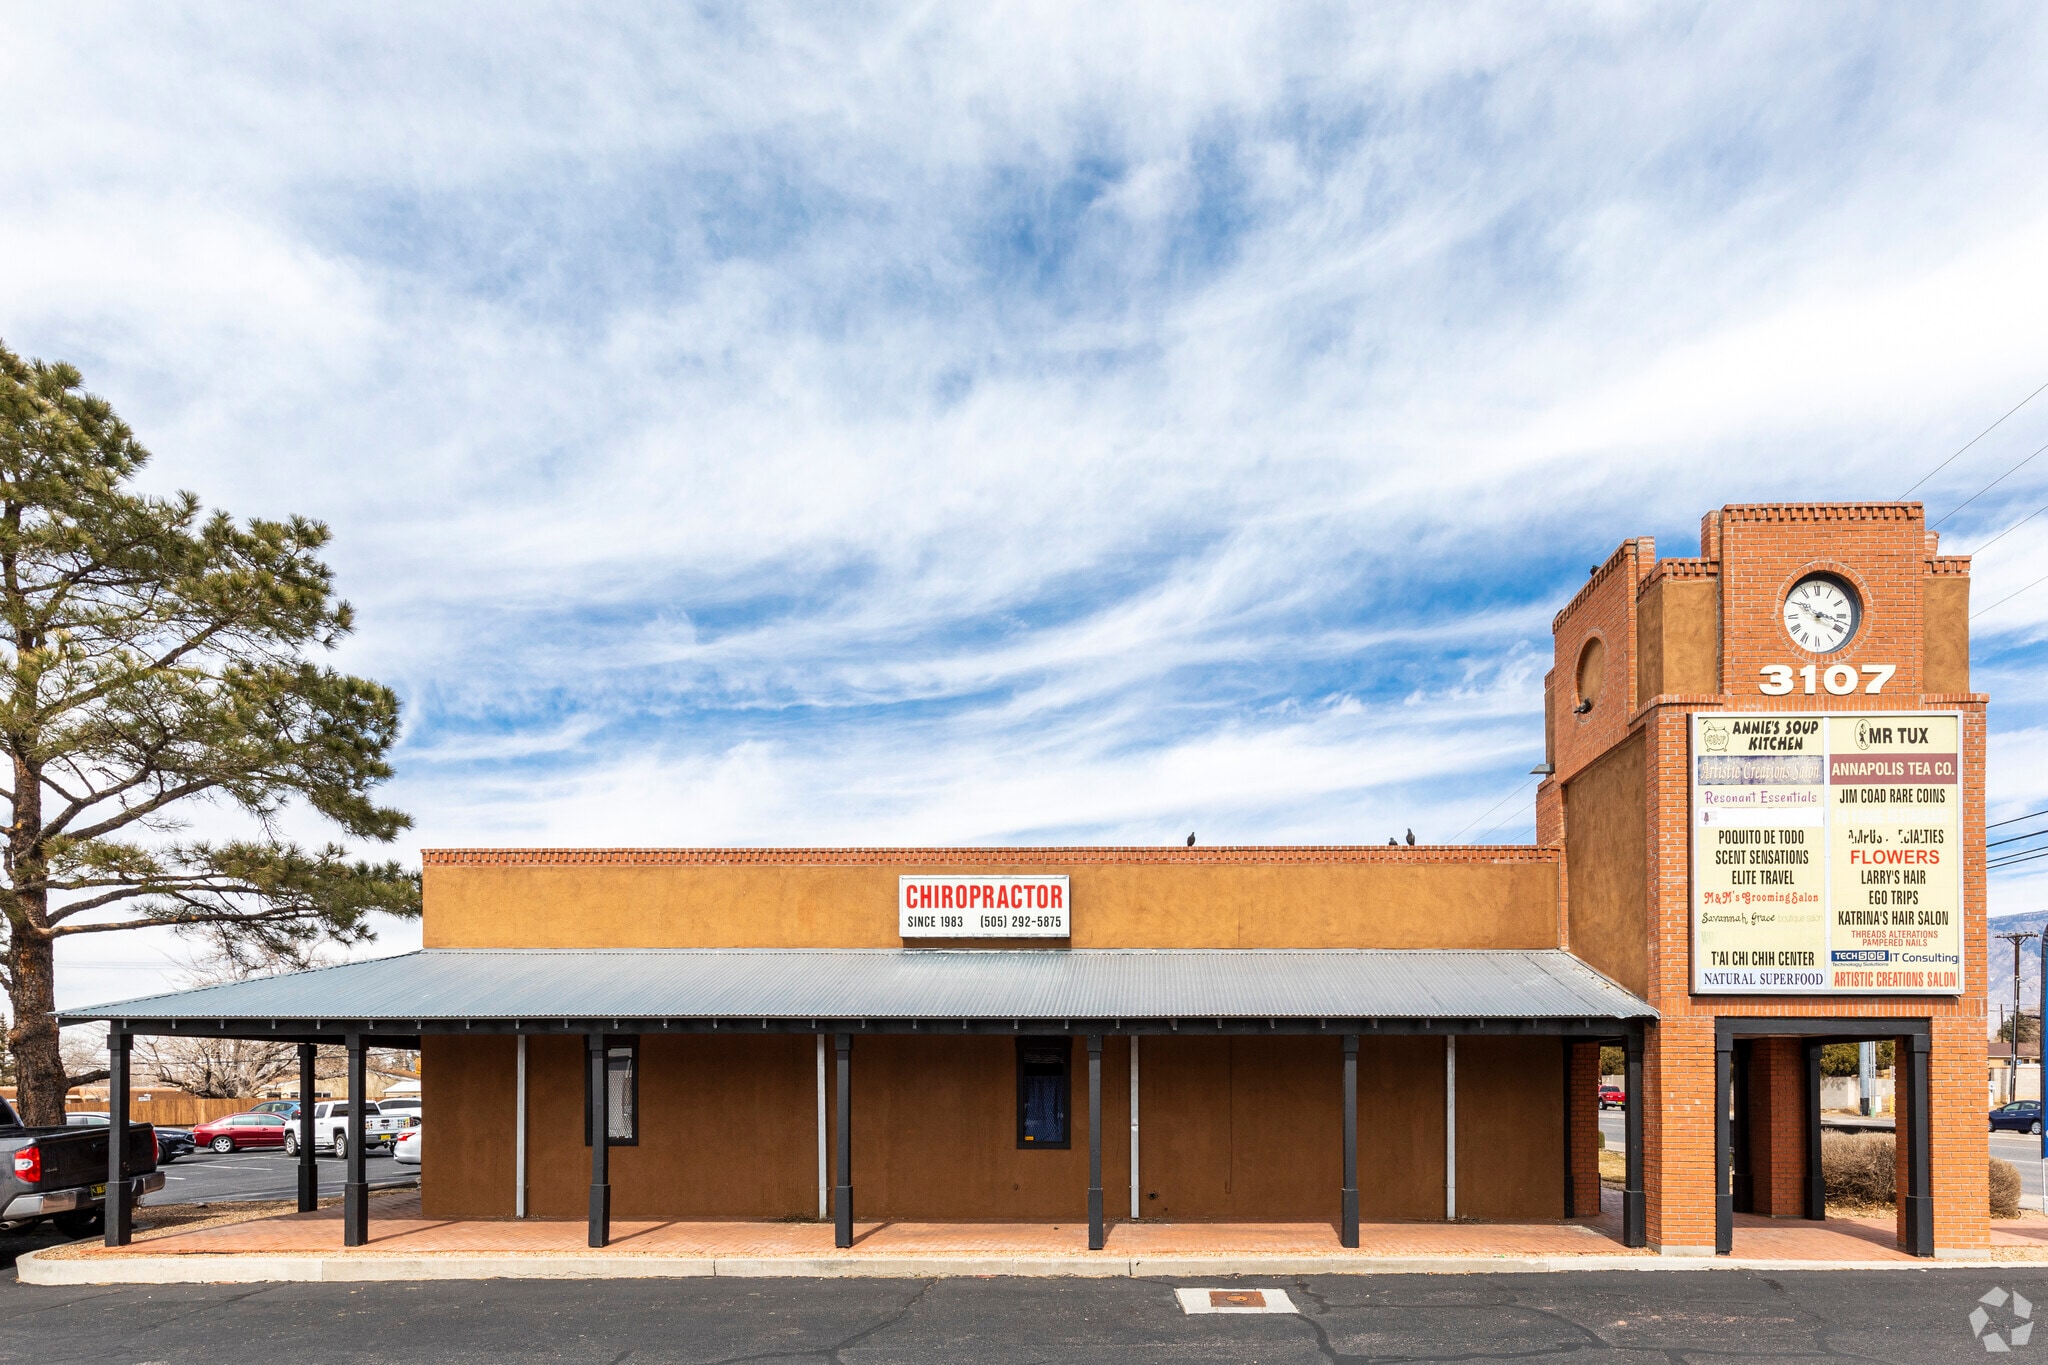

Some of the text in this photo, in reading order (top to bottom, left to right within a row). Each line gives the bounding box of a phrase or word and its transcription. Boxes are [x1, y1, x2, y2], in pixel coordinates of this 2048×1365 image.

[1759, 664, 1896, 696] 3107
[1732, 720, 1818, 734] ANNIE'S SOUP
[1748, 736, 1803, 750] KITCHEN
[1869, 728, 1928, 744] MR TUX
[1701, 761, 1740, 780] Artistic
[1743, 761, 1790, 779] Creations
[1832, 762, 1954, 776] ANNAPOLIS TEA CO.
[1704, 791, 1817, 804] Resonant Essentials
[1840, 788, 1945, 803] JIM COAD RARE COINS
[1719, 830, 1804, 844] POQUITO DE TODO
[1716, 850, 1809, 864] SCENT SENSATIONS
[1851, 850, 1940, 864] FLOWERS
[1732, 870, 1794, 884] ELITE TRAVEL
[1861, 870, 1926, 884] LARRY'S HAIR
[906, 884, 1062, 909] CHIROPRACTOR
[1869, 890, 1918, 904] EGO TRIPS
[908, 916, 1061, 928] SINCE 1983 (505) 292-5875
[1702, 912, 1748, 924] Savannah
[1751, 912, 1775, 925] Grace
[1838, 911, 1948, 925] KATRINA'S HAIR SALON
[1852, 930, 1938, 938] THREADS ALTERATIONS
[1711, 951, 1814, 966] T'AI CHI CHIH CENTER
[1890, 953, 1959, 964] IT Consulting
[1704, 973, 1823, 985] NATURAL SUPERFOOD
[1834, 972, 1956, 987] ARTISTIC CREATIONS SALON
